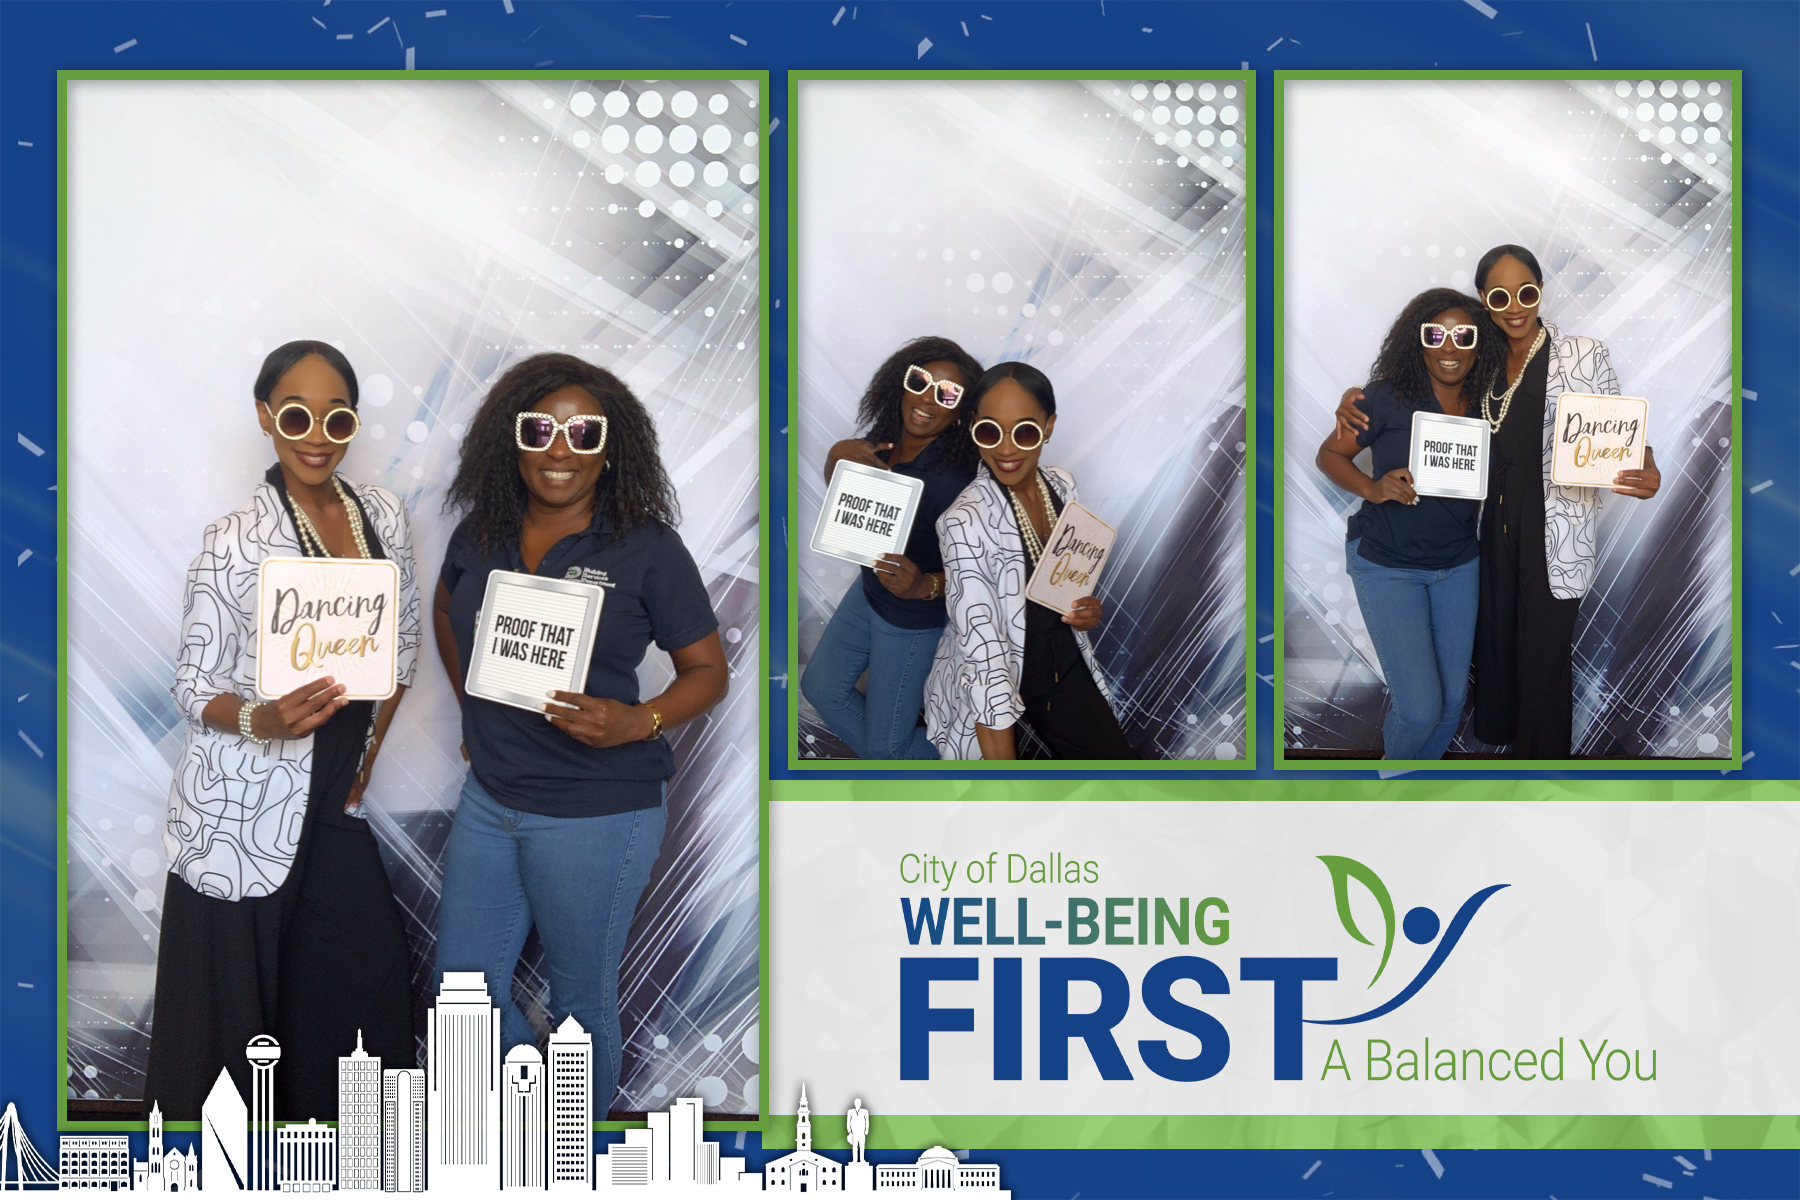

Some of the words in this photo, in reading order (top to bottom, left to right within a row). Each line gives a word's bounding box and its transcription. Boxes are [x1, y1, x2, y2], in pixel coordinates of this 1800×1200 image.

[1562, 413, 1640, 447] Dancing
[1424, 439, 1454, 454] PROOF
[1455, 443, 1478, 457] THAT
[1424, 454, 1428, 466] I
[1429, 455, 1450, 469] WAS
[1452, 457, 1476, 471] HERE
[1573, 436, 1633, 468] Queen
[834, 509, 841, 522] I
[841, 510, 866, 529] WAS
[865, 515, 895, 537] HERE
[838, 493, 873, 513] PROOF
[874, 500, 902, 521] THAT
[1052, 523, 1105, 574] Dancing
[582, 578, 616, 588] Department
[583, 573, 608, 581] Services
[585, 567, 607, 576] Building
[1049, 552, 1090, 588] Queen
[271, 587, 388, 635] Dancing
[290, 622, 379, 671] Queen
[494, 615, 537, 642] PROOF
[540, 622, 575, 647] THAT
[492, 636, 498, 655] I
[499, 638, 531, 661] WAS
[530, 643, 567, 670] HERE
